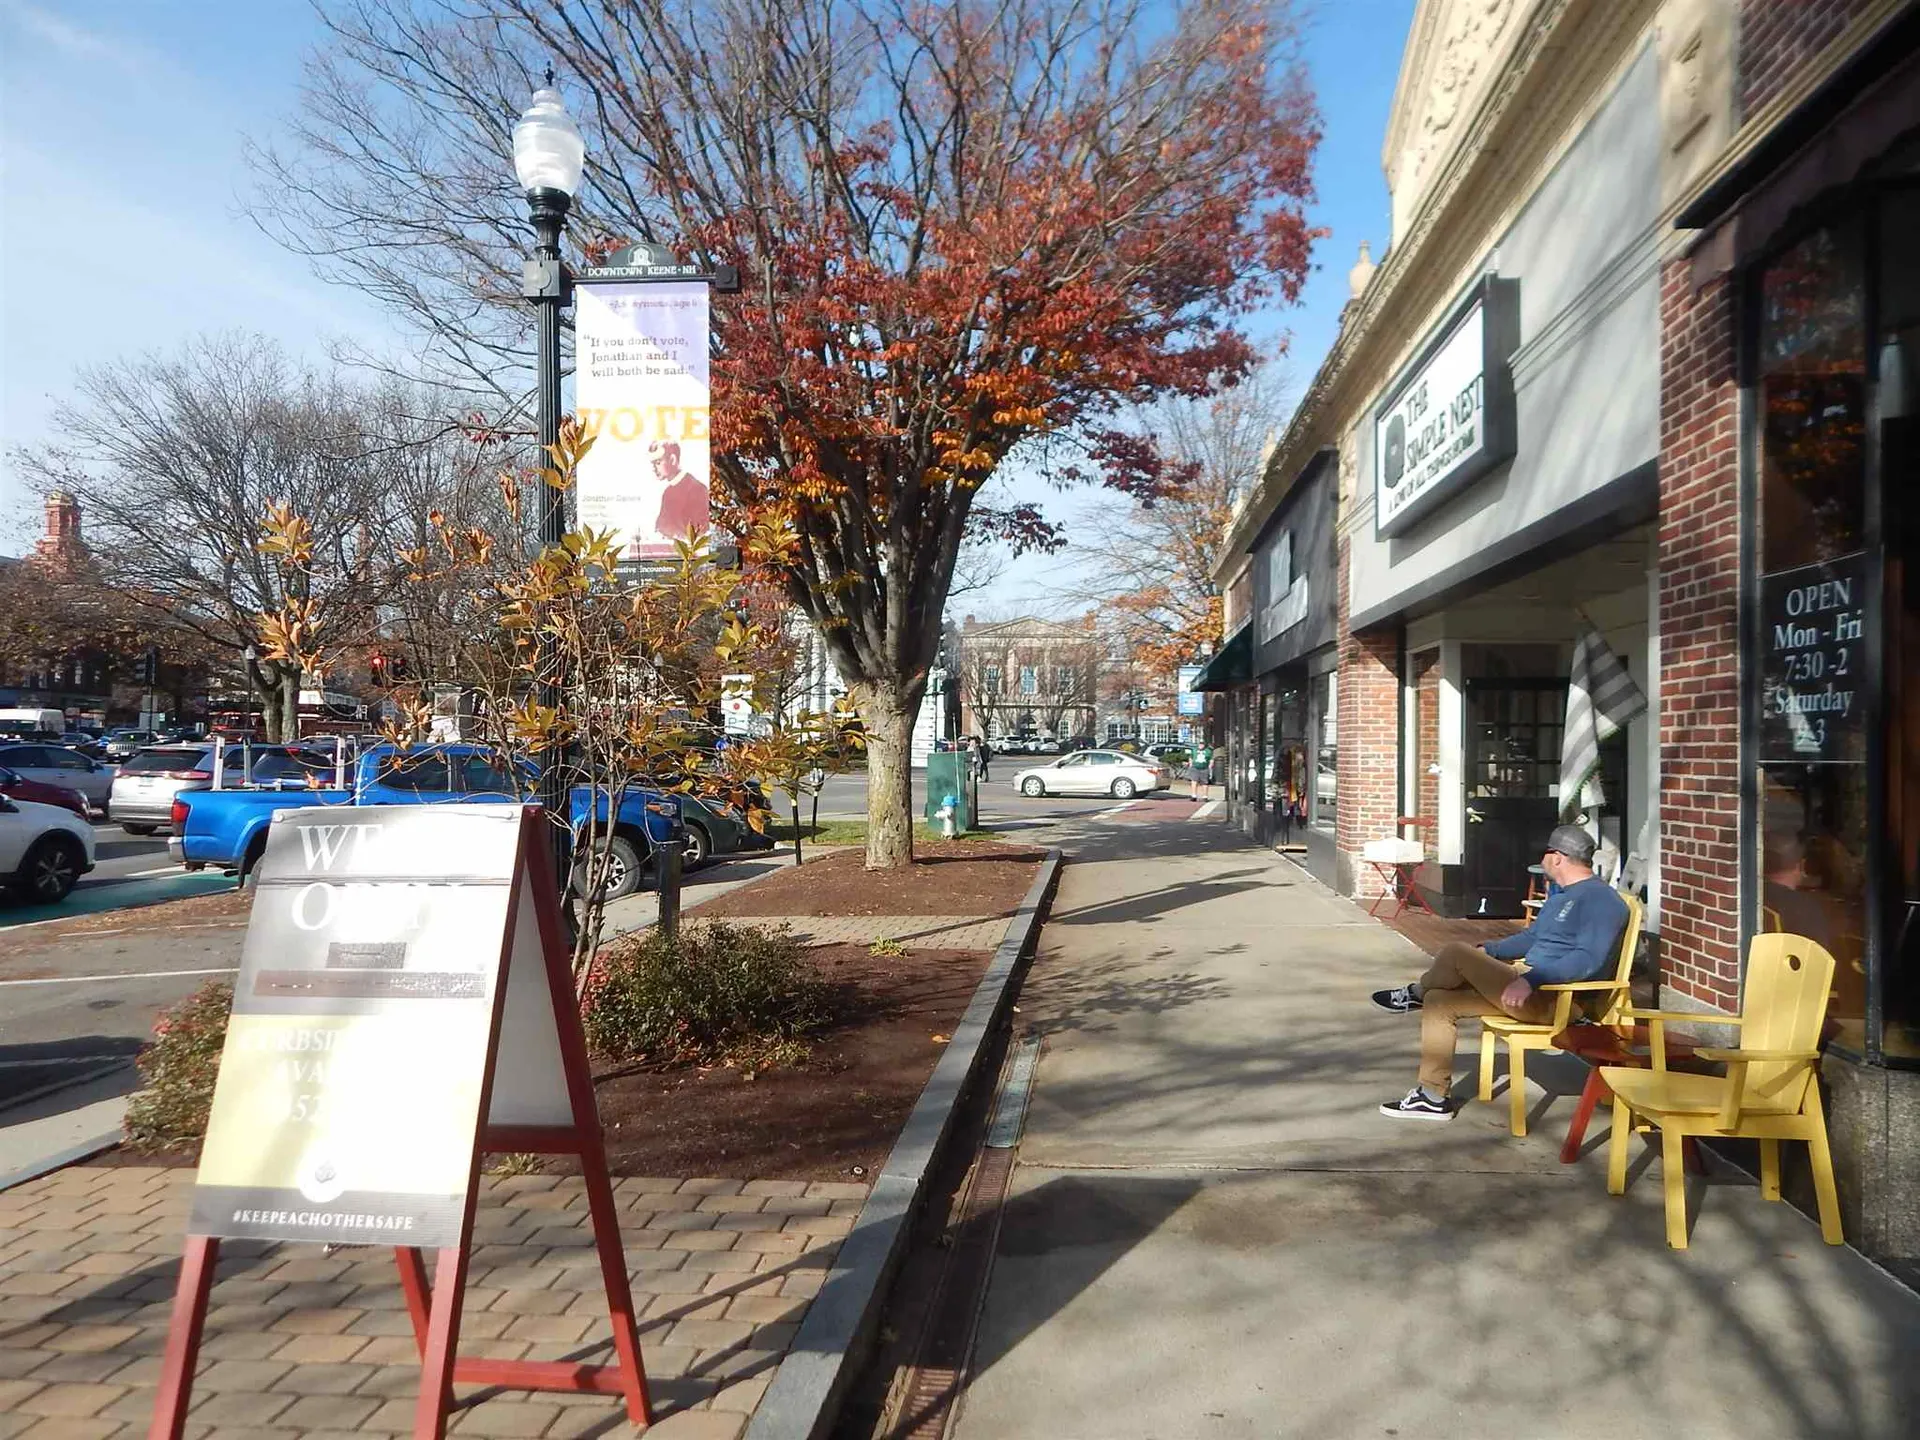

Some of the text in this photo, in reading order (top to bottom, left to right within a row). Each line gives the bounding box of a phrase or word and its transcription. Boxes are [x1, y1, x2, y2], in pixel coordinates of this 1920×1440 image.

[588, 267, 643, 277] DOWNTOWN
[591, 350, 678, 365] Jonathan and I
[603, 338, 624, 348] you
[660, 337, 689, 347] vote,
[592, 366, 614, 378] will
[617, 365, 642, 377] both
[646, 365, 660, 376] be
[1406, 380, 1428, 427] THE
[577, 405, 709, 441] VOTE
[1407, 370, 1483, 473] SIMPLE NEST
[612, 565, 637, 574] reative
[1786, 577, 1852, 616] OPEN
[1773, 622, 1816, 650] Mon
[1835, 609, 1863, 642] Fri
[1784, 650, 1824, 681] 7:30
[1775, 682, 1856, 718] Saturday
[233, 1209, 413, 1230] #KEEPEACHOTHERSAFE
